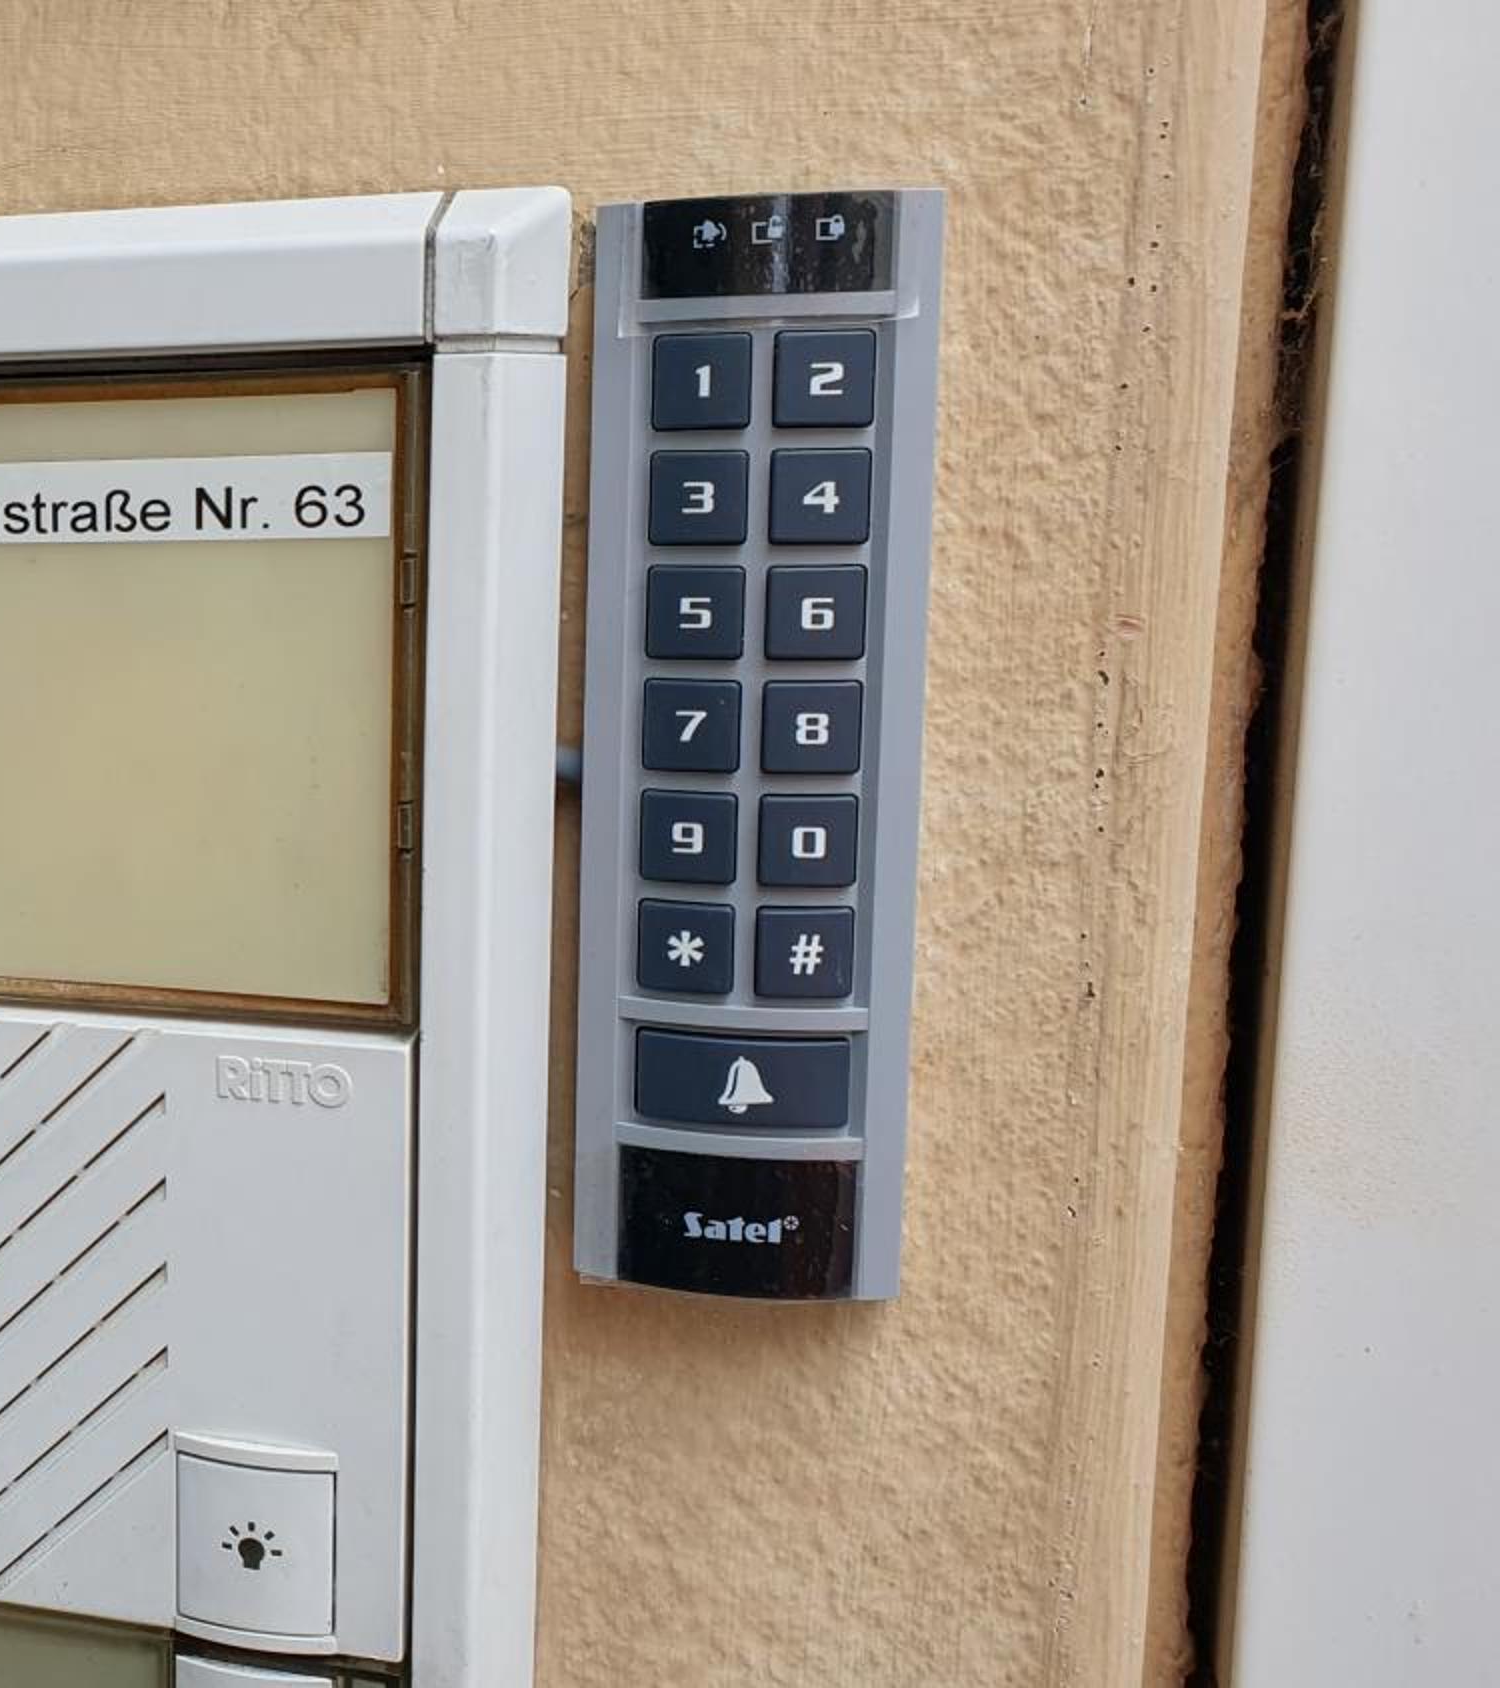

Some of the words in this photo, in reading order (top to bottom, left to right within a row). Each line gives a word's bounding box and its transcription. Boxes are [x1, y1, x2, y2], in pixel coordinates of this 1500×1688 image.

[694, 364, 712, 398] 1
[808, 361, 845, 396] 2
[194, 485, 271, 531] Nr.
[293, 483, 366, 528] 63
[681, 481, 715, 514] 3
[802, 480, 840, 514] 4
[679, 596, 713, 630] 5
[800, 596, 835, 631] 6
[674, 710, 708, 743] 7
[794, 711, 830, 746] 8
[671, 821, 705, 855] 9
[791, 826, 828, 860] 0
[788, 933, 825, 976] #
[682, 1211, 784, 1244] Satel
